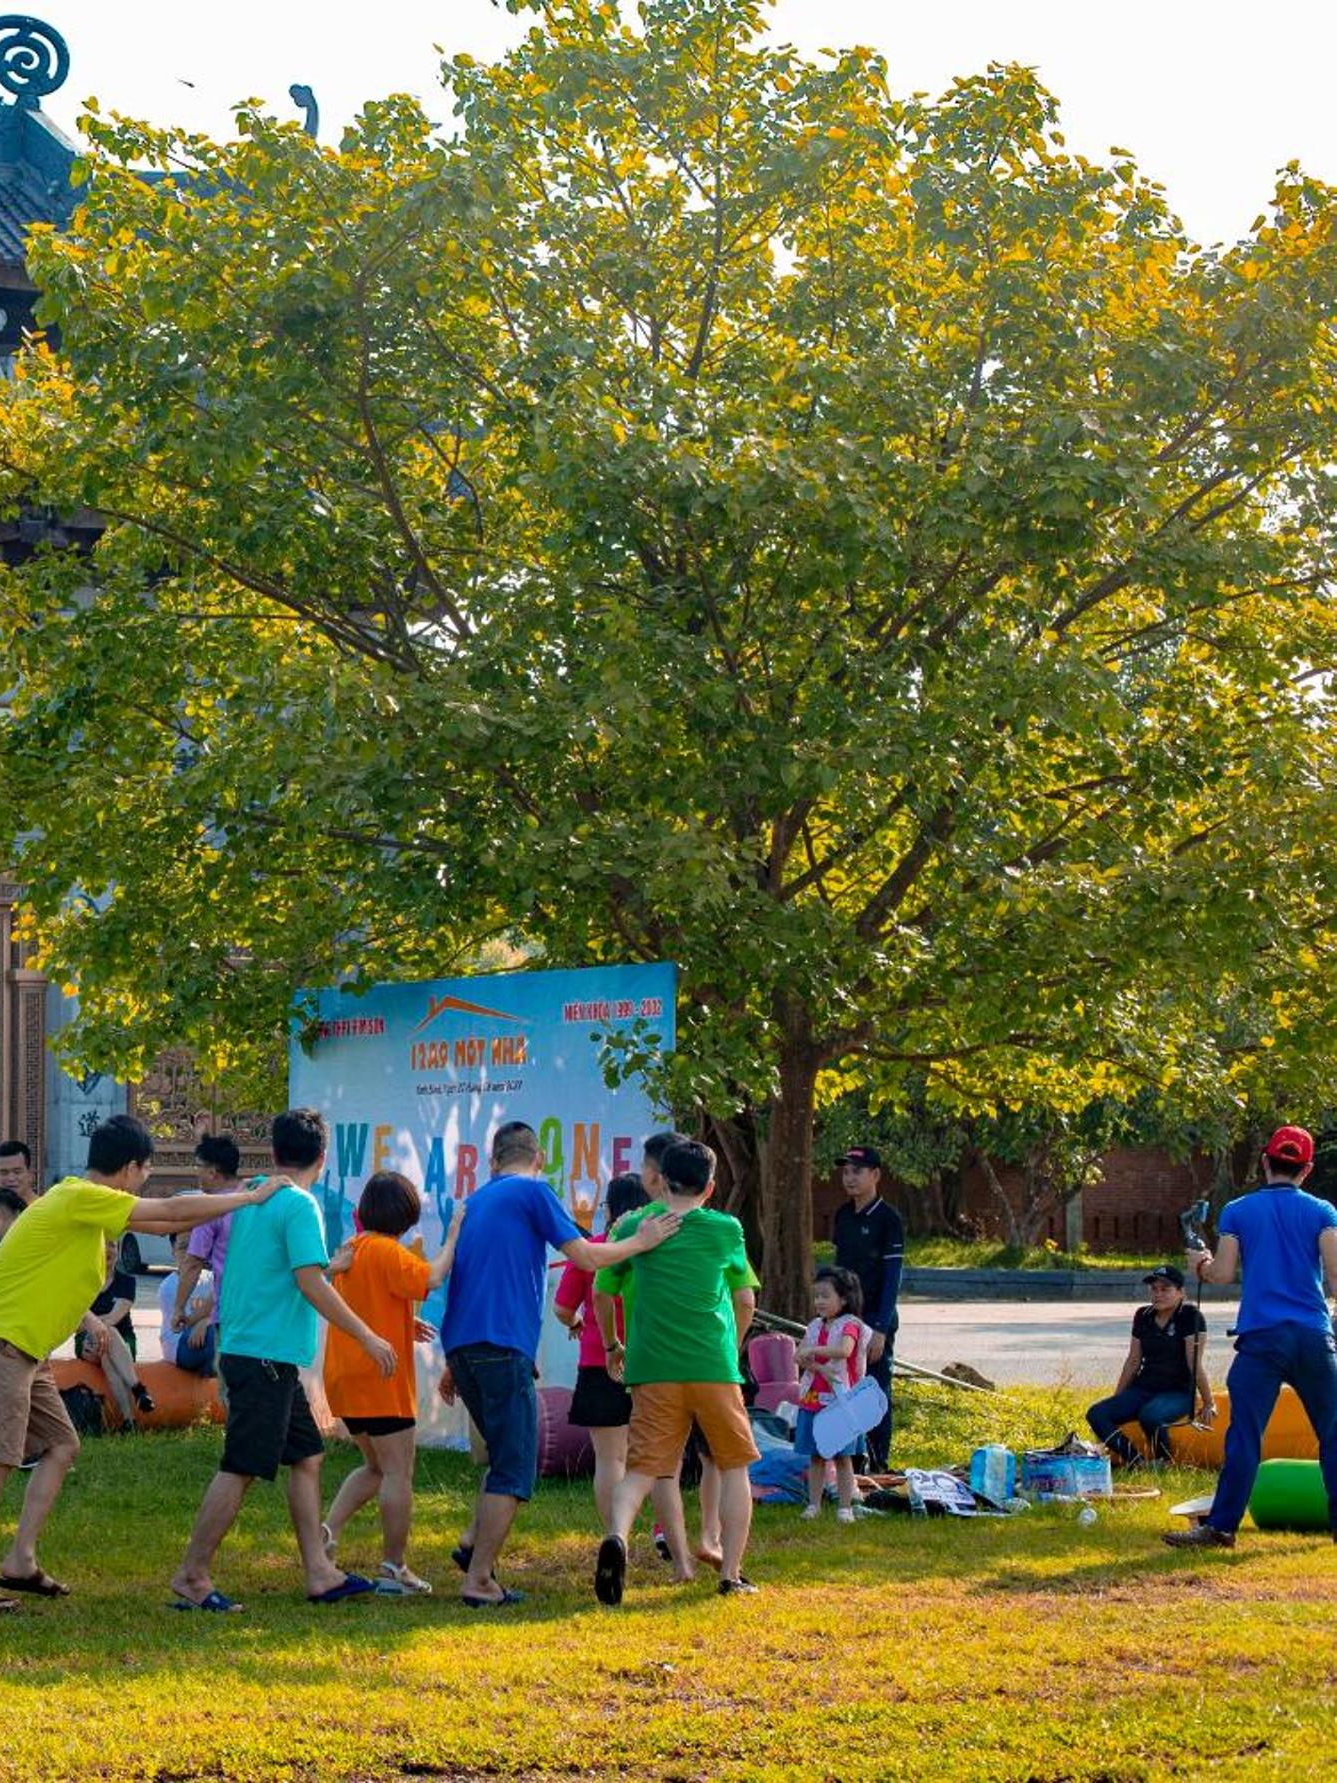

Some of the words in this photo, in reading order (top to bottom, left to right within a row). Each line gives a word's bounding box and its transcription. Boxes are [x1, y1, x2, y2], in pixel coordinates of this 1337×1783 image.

[335, 1122, 392, 1178] WE
[425, 1136, 479, 1200] AR
[539, 1116, 632, 1180] ONE
